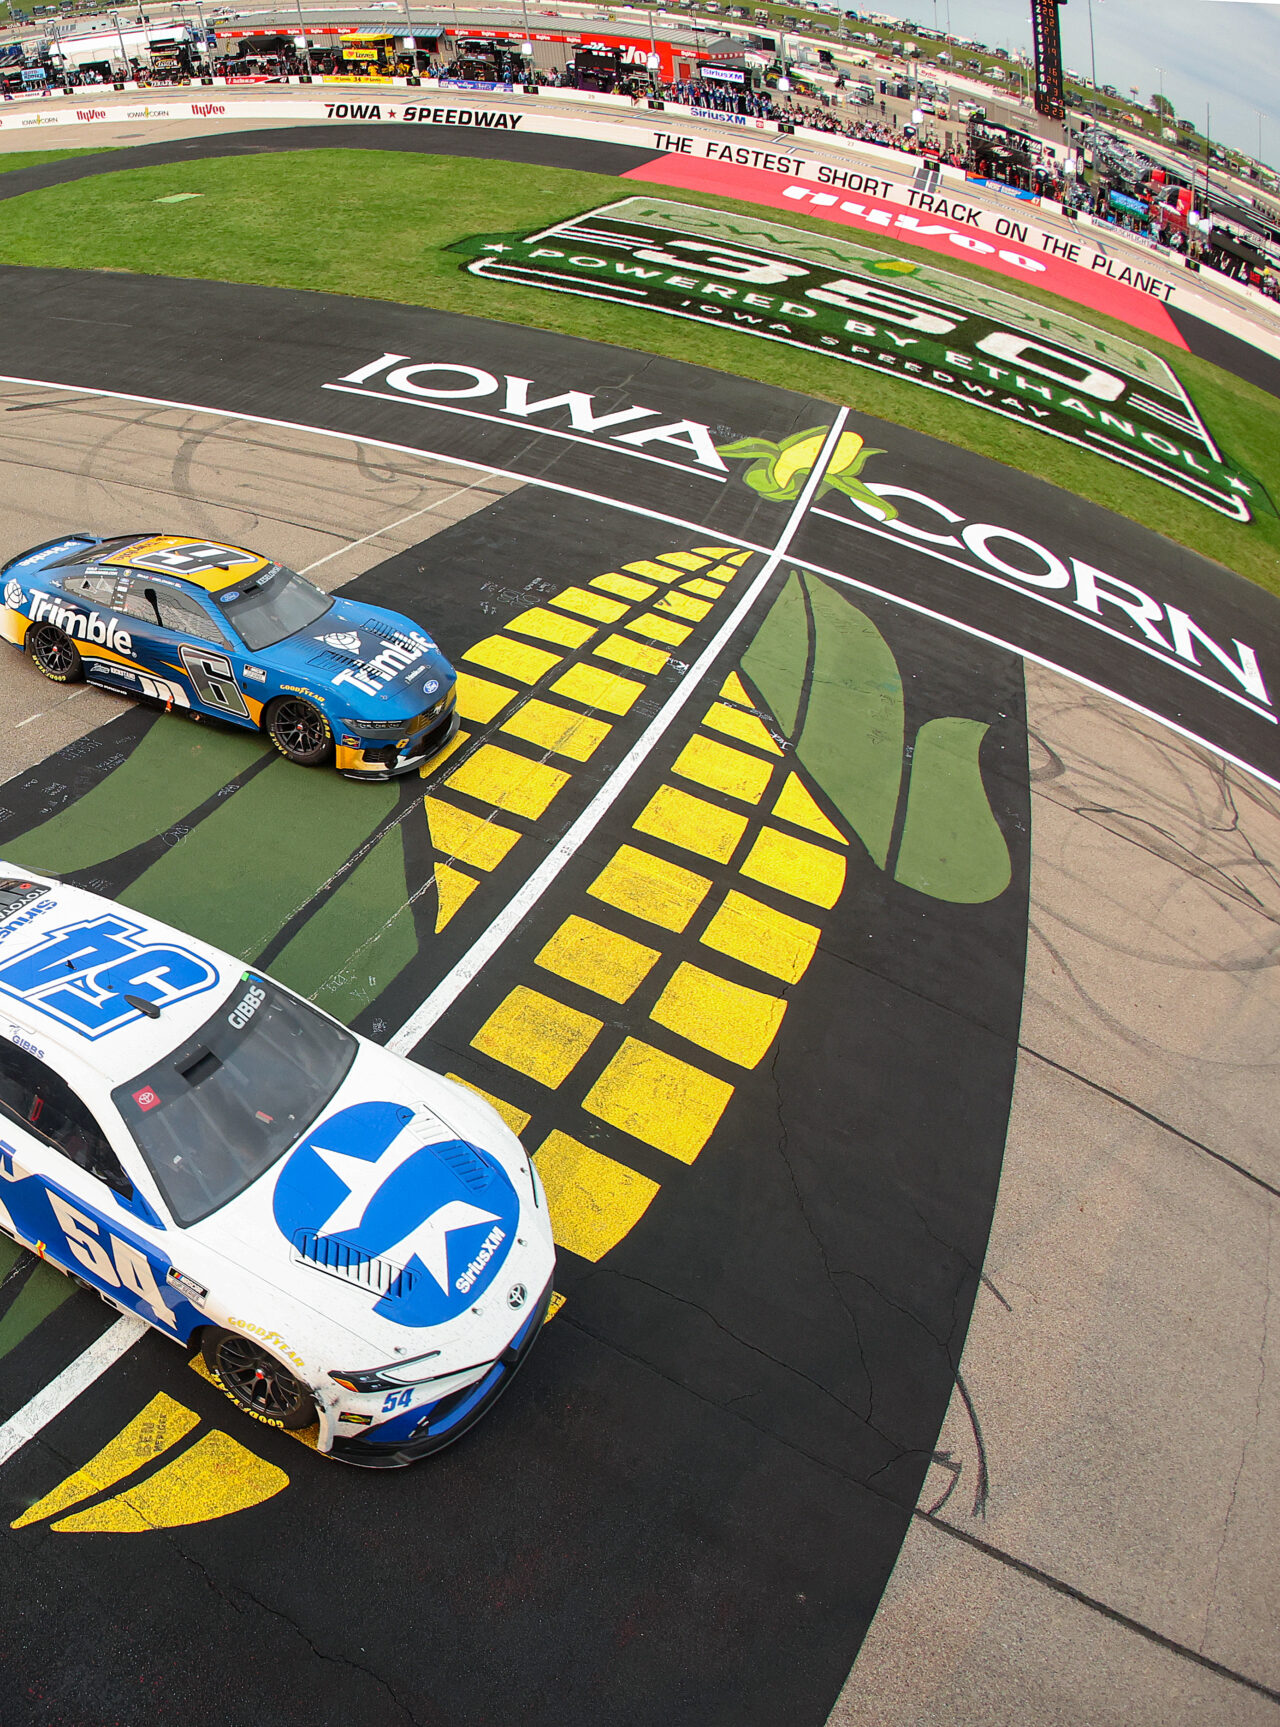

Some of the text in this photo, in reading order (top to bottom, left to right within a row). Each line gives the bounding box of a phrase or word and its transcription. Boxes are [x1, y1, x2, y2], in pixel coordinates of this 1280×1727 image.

[1036, 5, 1041, 13] 2
[1037, 15, 1041, 23] 3
[1038, 34, 1043, 42] 5
[1039, 44, 1044, 52] 6
[1039, 54, 1044, 62] 7
[1040, 64, 1044, 72] 8
[702, 68, 744, 81] SiriusXM
[1040, 74, 1045, 82] 9
[1039, 84, 1047, 93] 10
[76, 110, 106, 122] HyVee
[192, 104, 225, 117] HyVee
[324, 103, 523, 130] IOWA SPEEDWAY
[690, 107, 746, 126] SiriusXM
[653, 133, 694, 154] THE
[705, 142, 806, 176] FASTEST
[817, 166, 894, 198] SHORT
[908, 189, 983, 227] TRACK
[995, 218, 1028, 243] ON
[1041, 233, 1082, 263] THE
[1091, 254, 1177, 302] PLANET
[782, 185, 1047, 273] HyVee
[632, 240, 1127, 402] 350
[528, 248, 1210, 475] POWERED BY ETHANOL
[680, 300, 1050, 418] IOWA SPEEDWAY
[336, 352, 1272, 708] IOWA CORN
[28, 588, 133, 655] Trimble
[331, 630, 436, 697] Trimble
[178, 642, 250, 720] 6
[279, 683, 326, 703] GOODYEAR
[227, 985, 266, 1030] GIBBS
[11, 1035, 45, 1059] GIBBS
[45, 1187, 178, 1331] 54
[455, 1226, 506, 1294] SiriusXM
[227, 1316, 305, 1368] GOODYEAR
[211, 1372, 285, 1429] GOODYEAR
[381, 1388, 415, 1413] 54
